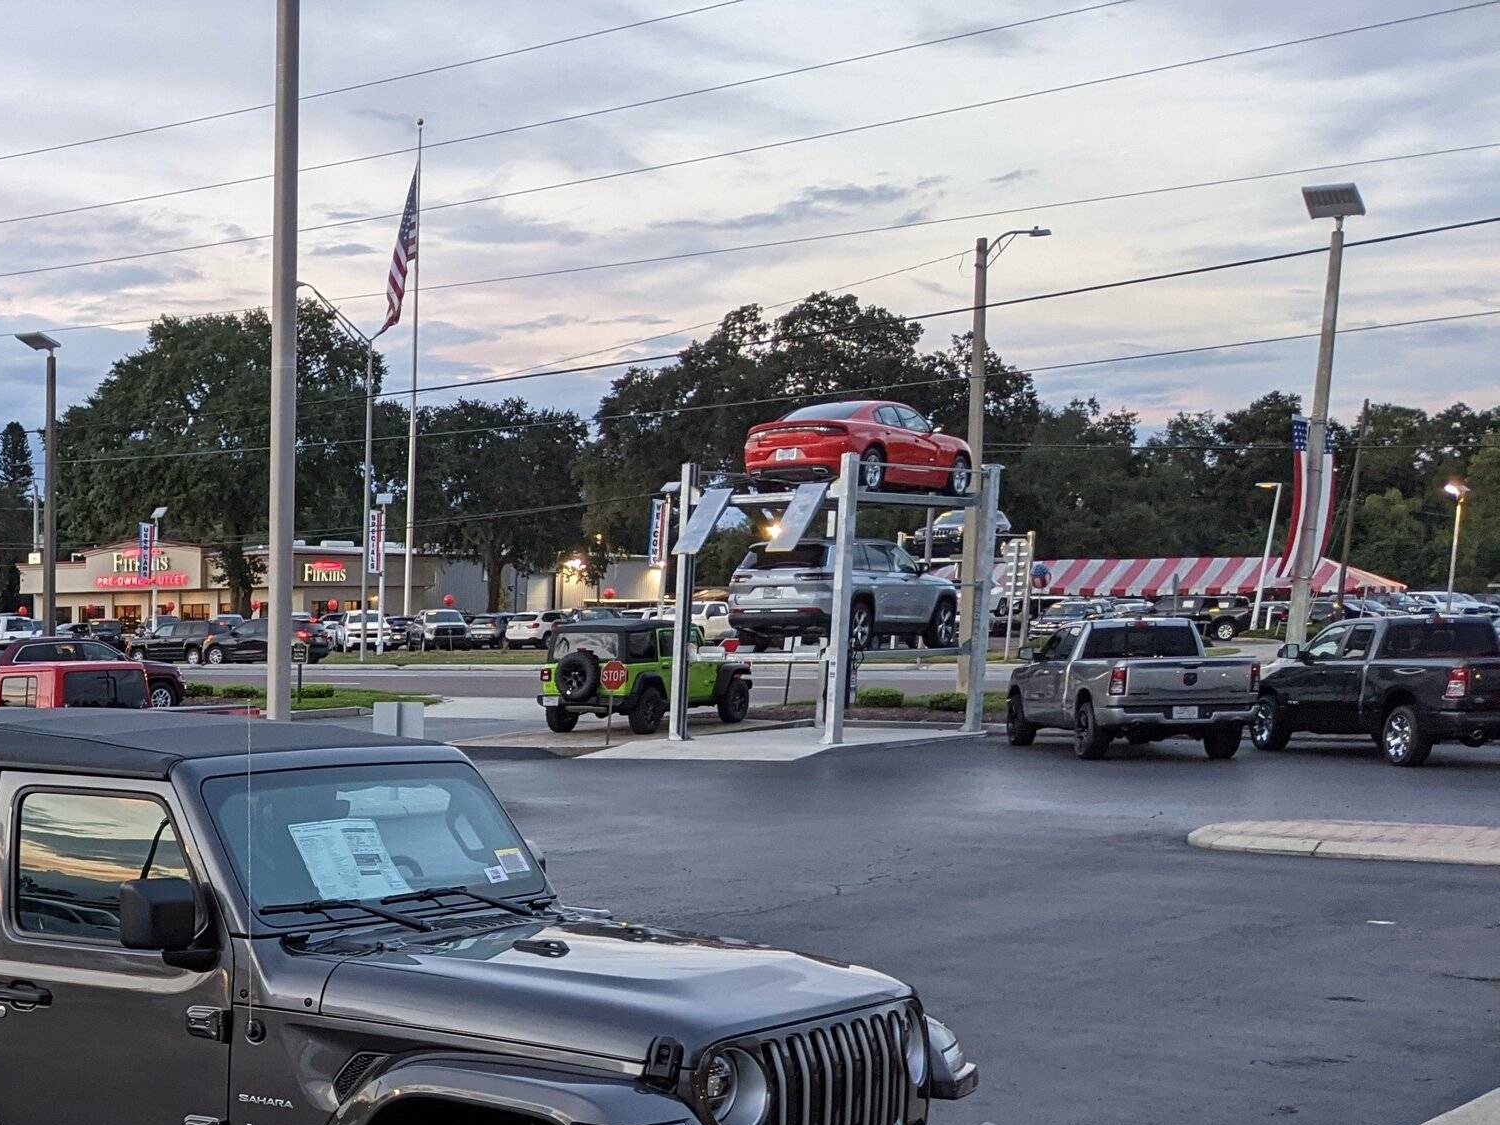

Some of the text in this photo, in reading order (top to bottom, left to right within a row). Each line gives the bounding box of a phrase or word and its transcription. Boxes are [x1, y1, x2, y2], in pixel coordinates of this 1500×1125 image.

[112, 552, 170, 573] Firkns
[97, 576, 151, 587] PRE-OWN
[602, 670, 626, 682] STOP
[238, 1093, 294, 1110] SAHARA
